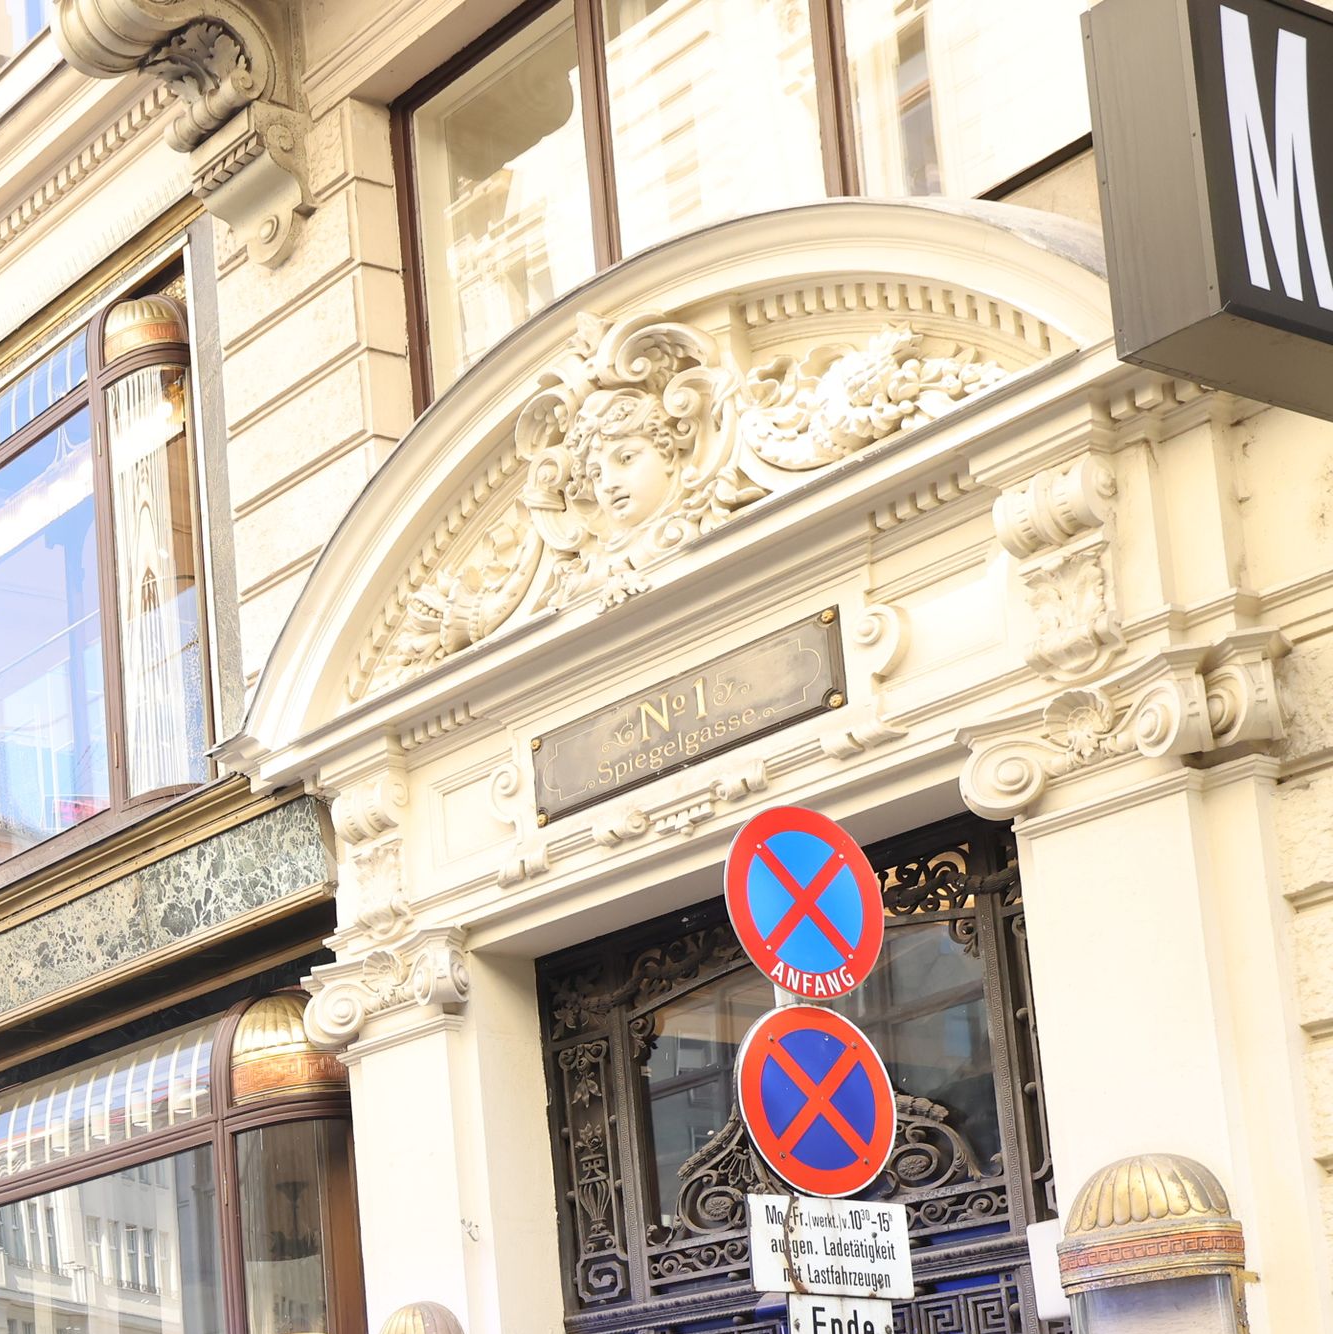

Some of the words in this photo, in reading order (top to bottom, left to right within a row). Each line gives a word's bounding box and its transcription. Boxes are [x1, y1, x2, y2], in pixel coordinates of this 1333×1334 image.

[691, 676, 709, 721] 1
[770, 960, 855, 996] ANFANG
[771, 1237, 818, 1258] augen.
[823, 1236, 896, 1264] Ladetätigkeit
[807, 1263, 891, 1292] Lastfahrzeugen
